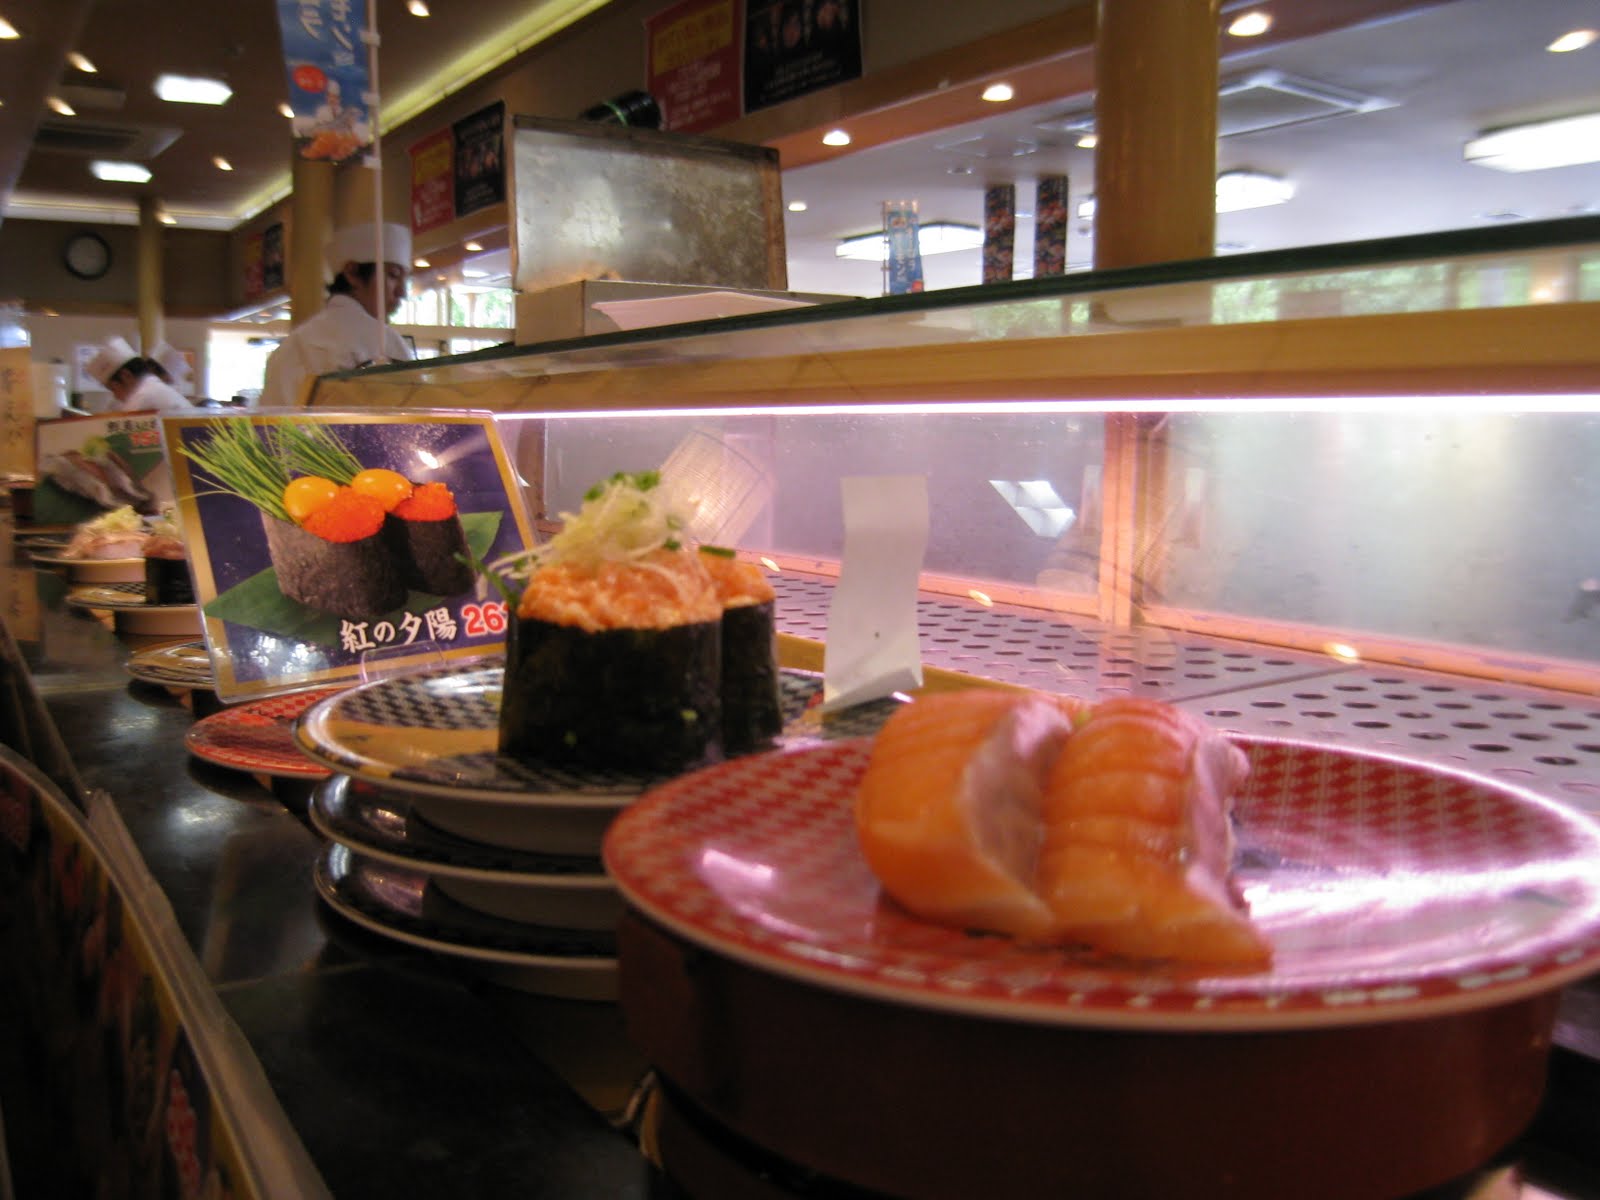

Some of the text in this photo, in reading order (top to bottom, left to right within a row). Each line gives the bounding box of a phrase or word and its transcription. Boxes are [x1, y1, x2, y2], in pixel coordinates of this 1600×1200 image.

[340, 601, 508, 654] 紅の夕陽 26
